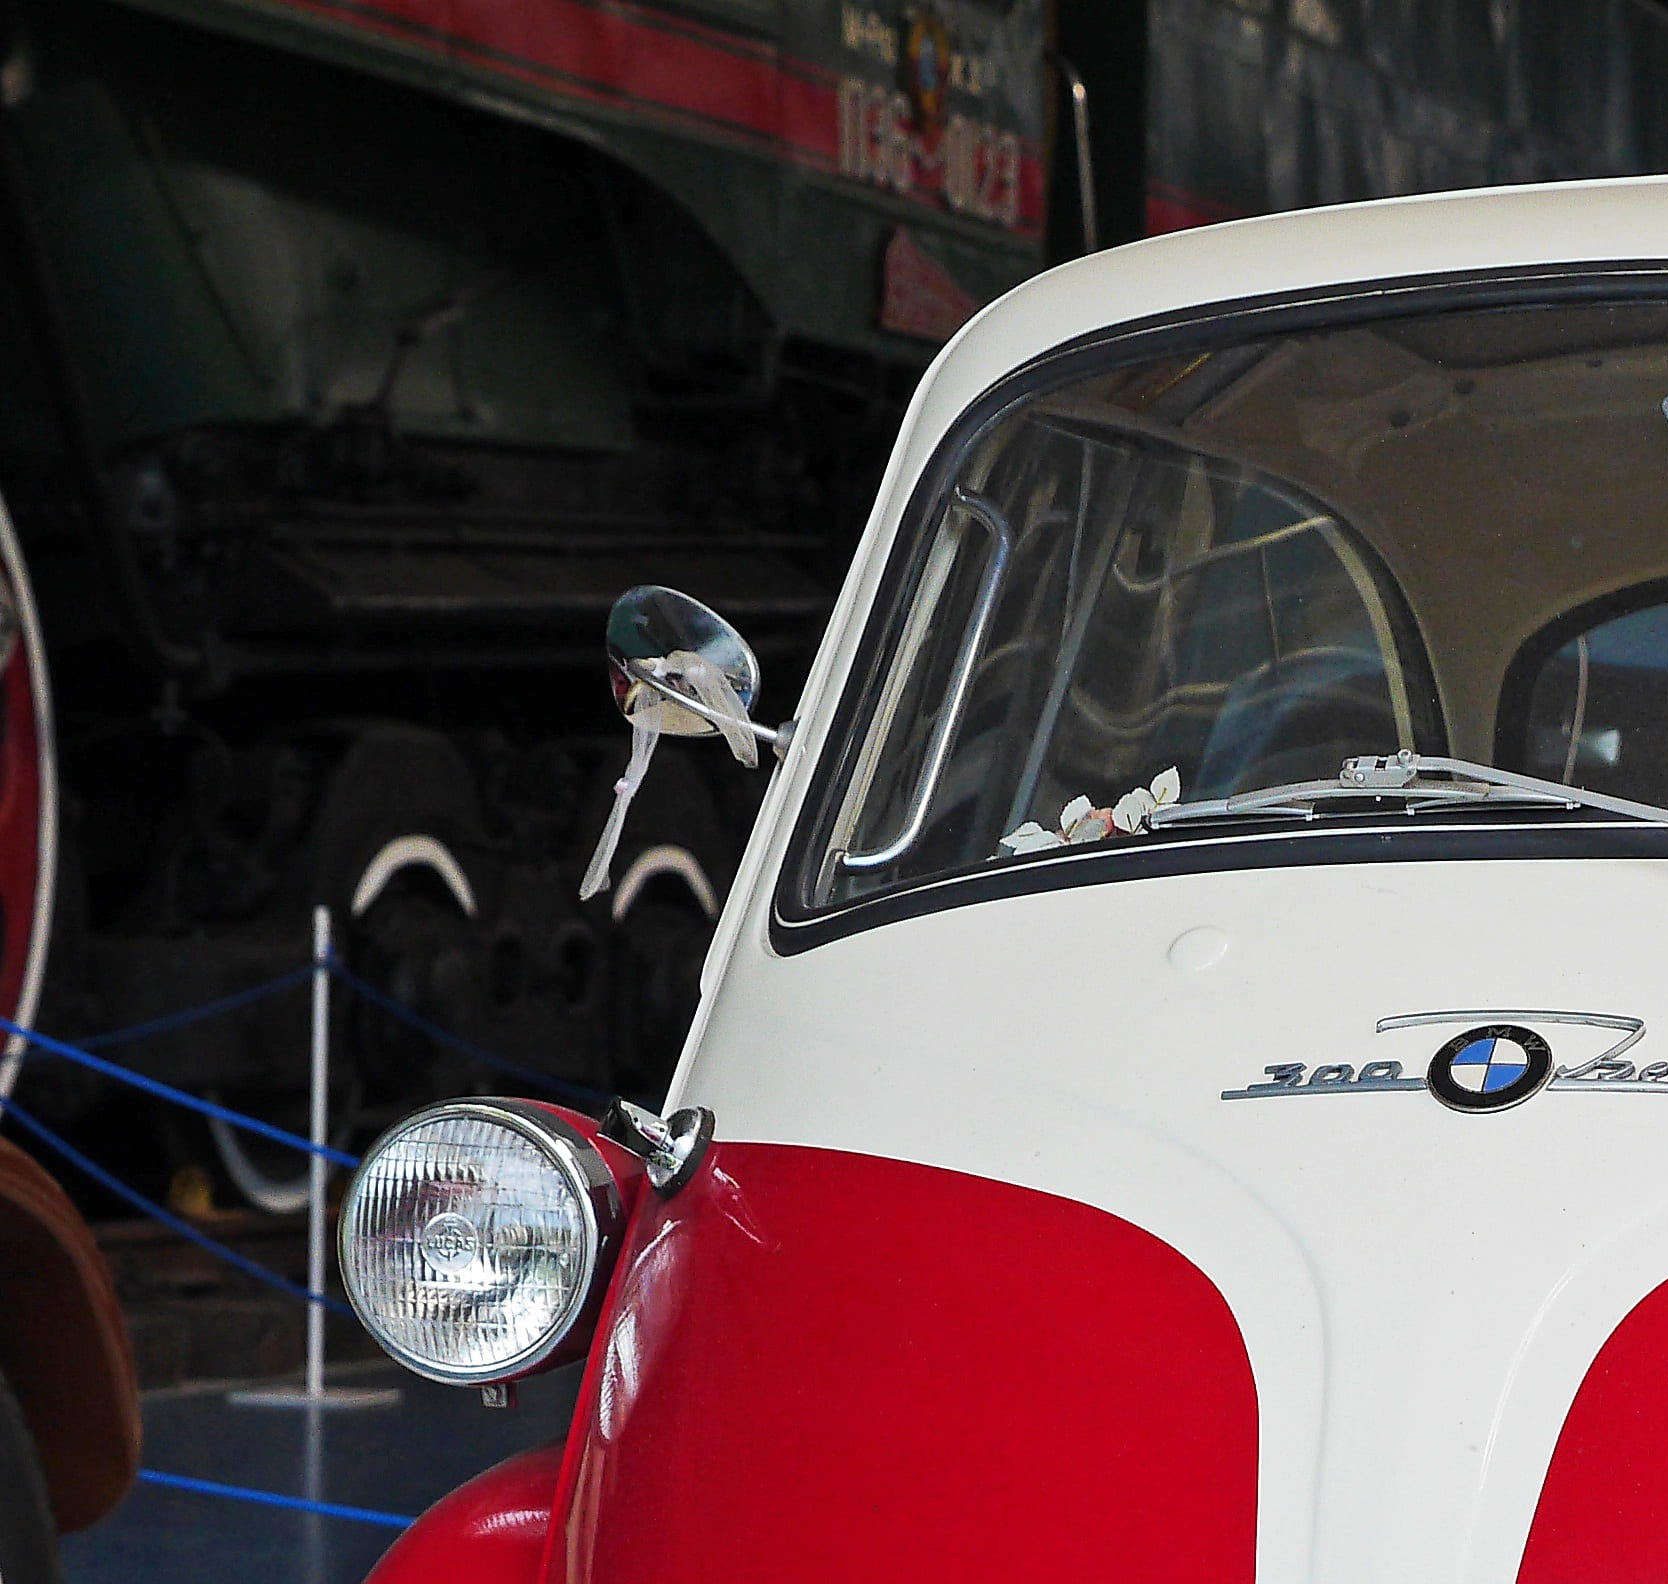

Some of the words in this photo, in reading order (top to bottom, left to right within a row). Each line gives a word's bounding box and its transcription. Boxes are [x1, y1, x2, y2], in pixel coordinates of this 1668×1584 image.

[1448, 1026, 1547, 1053] BMW
[1264, 1061, 1404, 1088] 300
[426, 1235, 475, 1250] LUCAS
